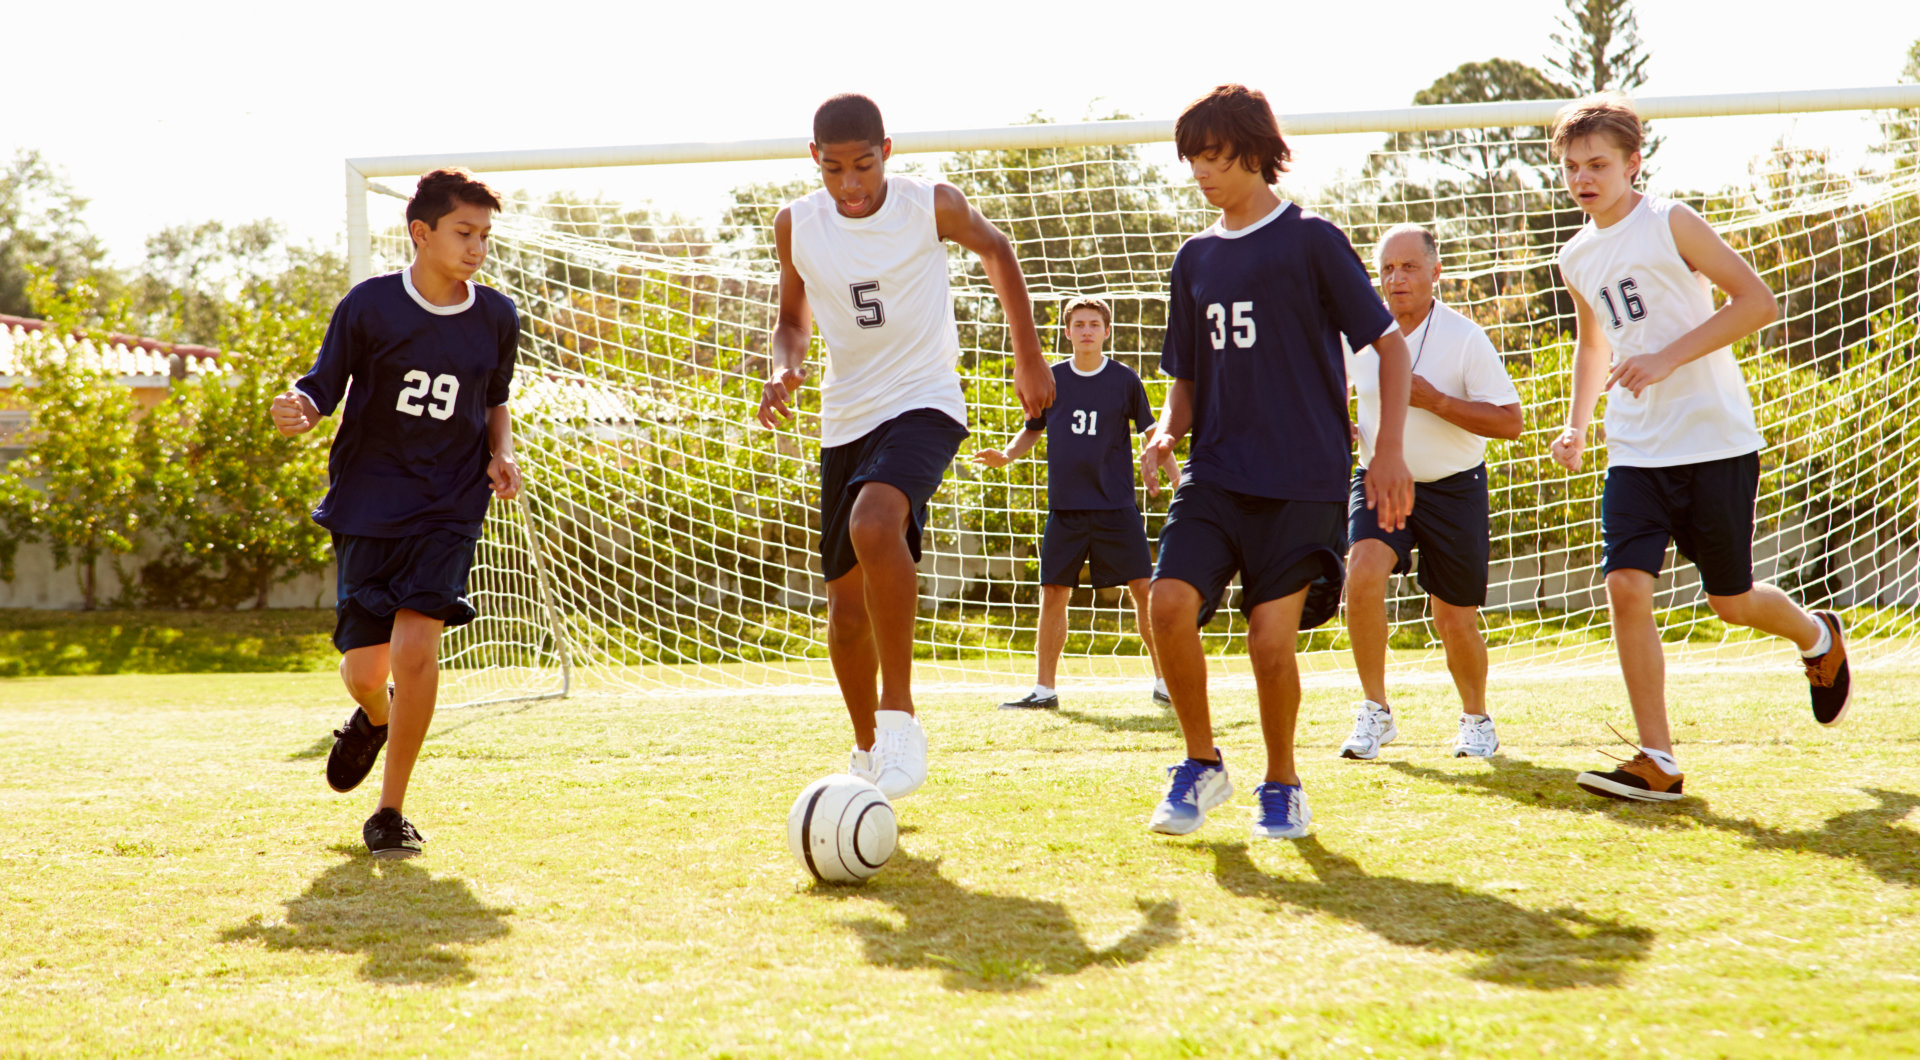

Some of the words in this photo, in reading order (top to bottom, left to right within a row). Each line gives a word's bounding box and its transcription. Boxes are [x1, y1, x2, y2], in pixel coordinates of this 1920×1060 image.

[849, 280, 886, 329] 5
[1206, 301, 1257, 350] 35
[1600, 277, 1648, 329] 16
[395, 369, 460, 421] 29
[1071, 409, 1098, 436] 31
